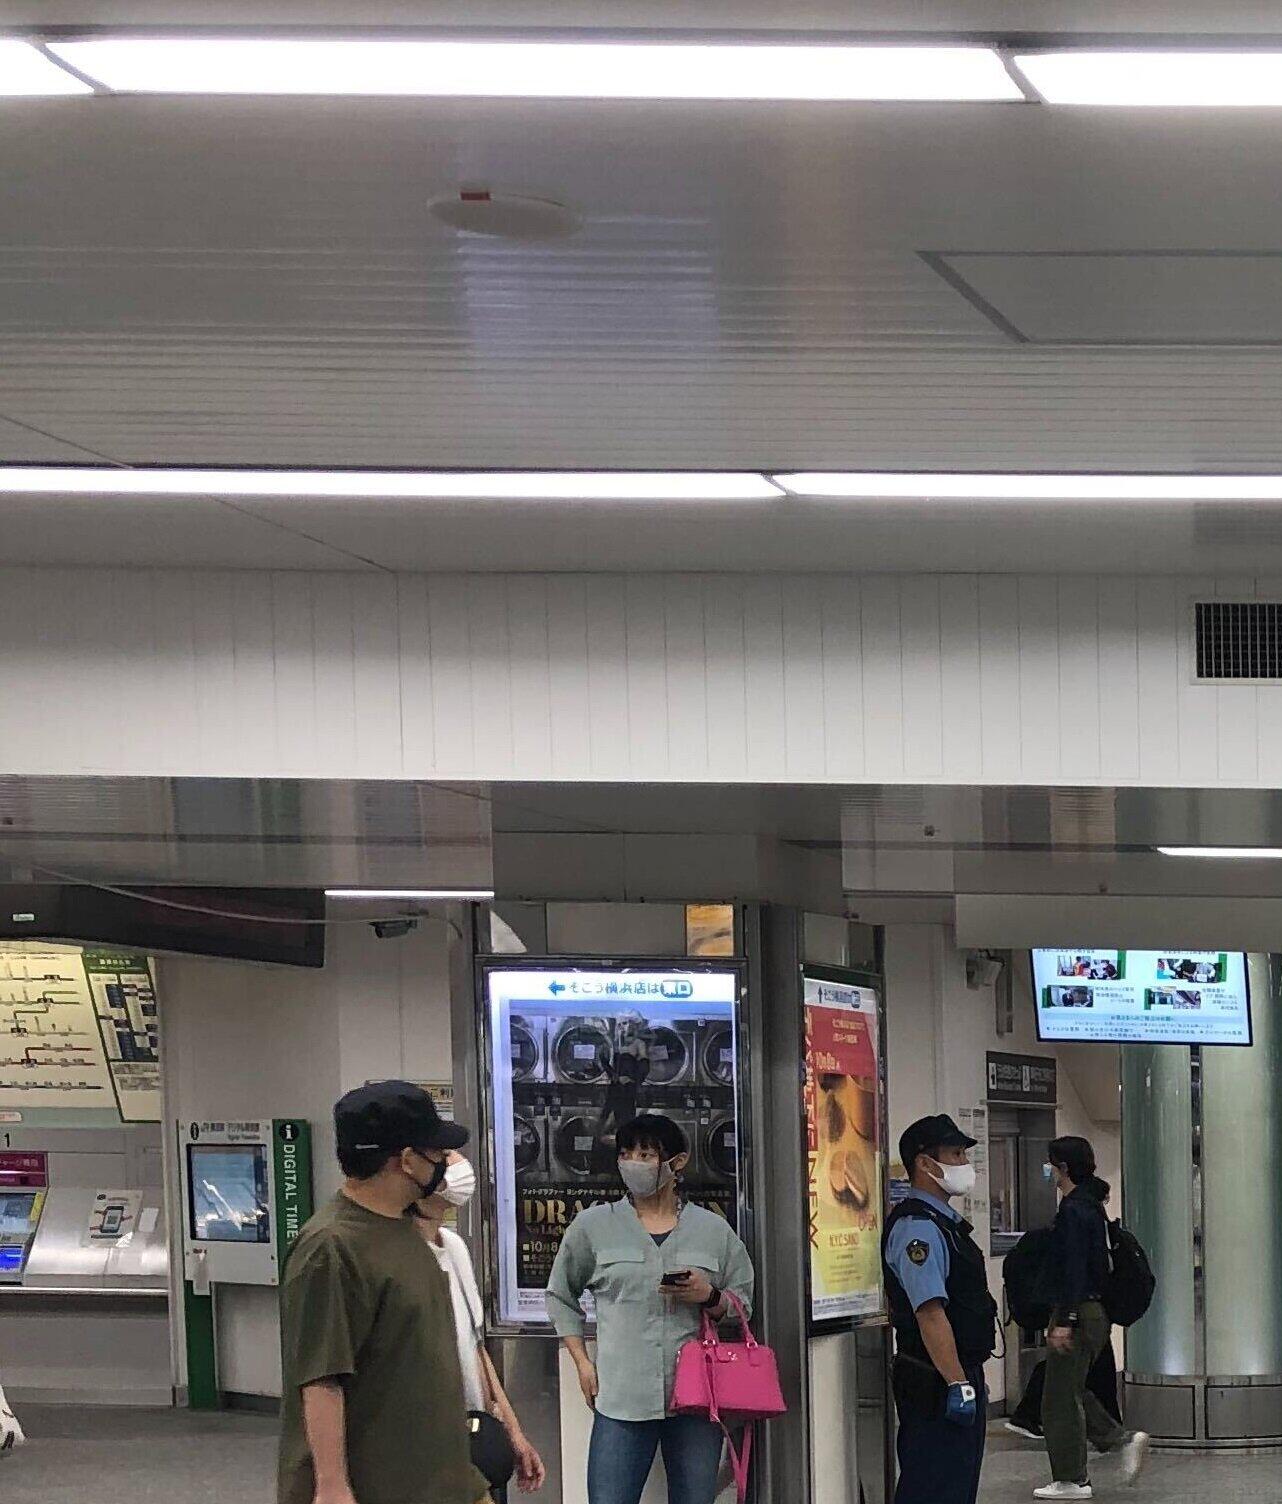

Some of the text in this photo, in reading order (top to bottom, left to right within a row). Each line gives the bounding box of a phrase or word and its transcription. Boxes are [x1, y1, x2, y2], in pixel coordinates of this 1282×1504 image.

[4, 1133, 11, 1147] 1
[283, 1144, 298, 1200] DIGITAL
[285, 1204, 301, 1241] TIME
